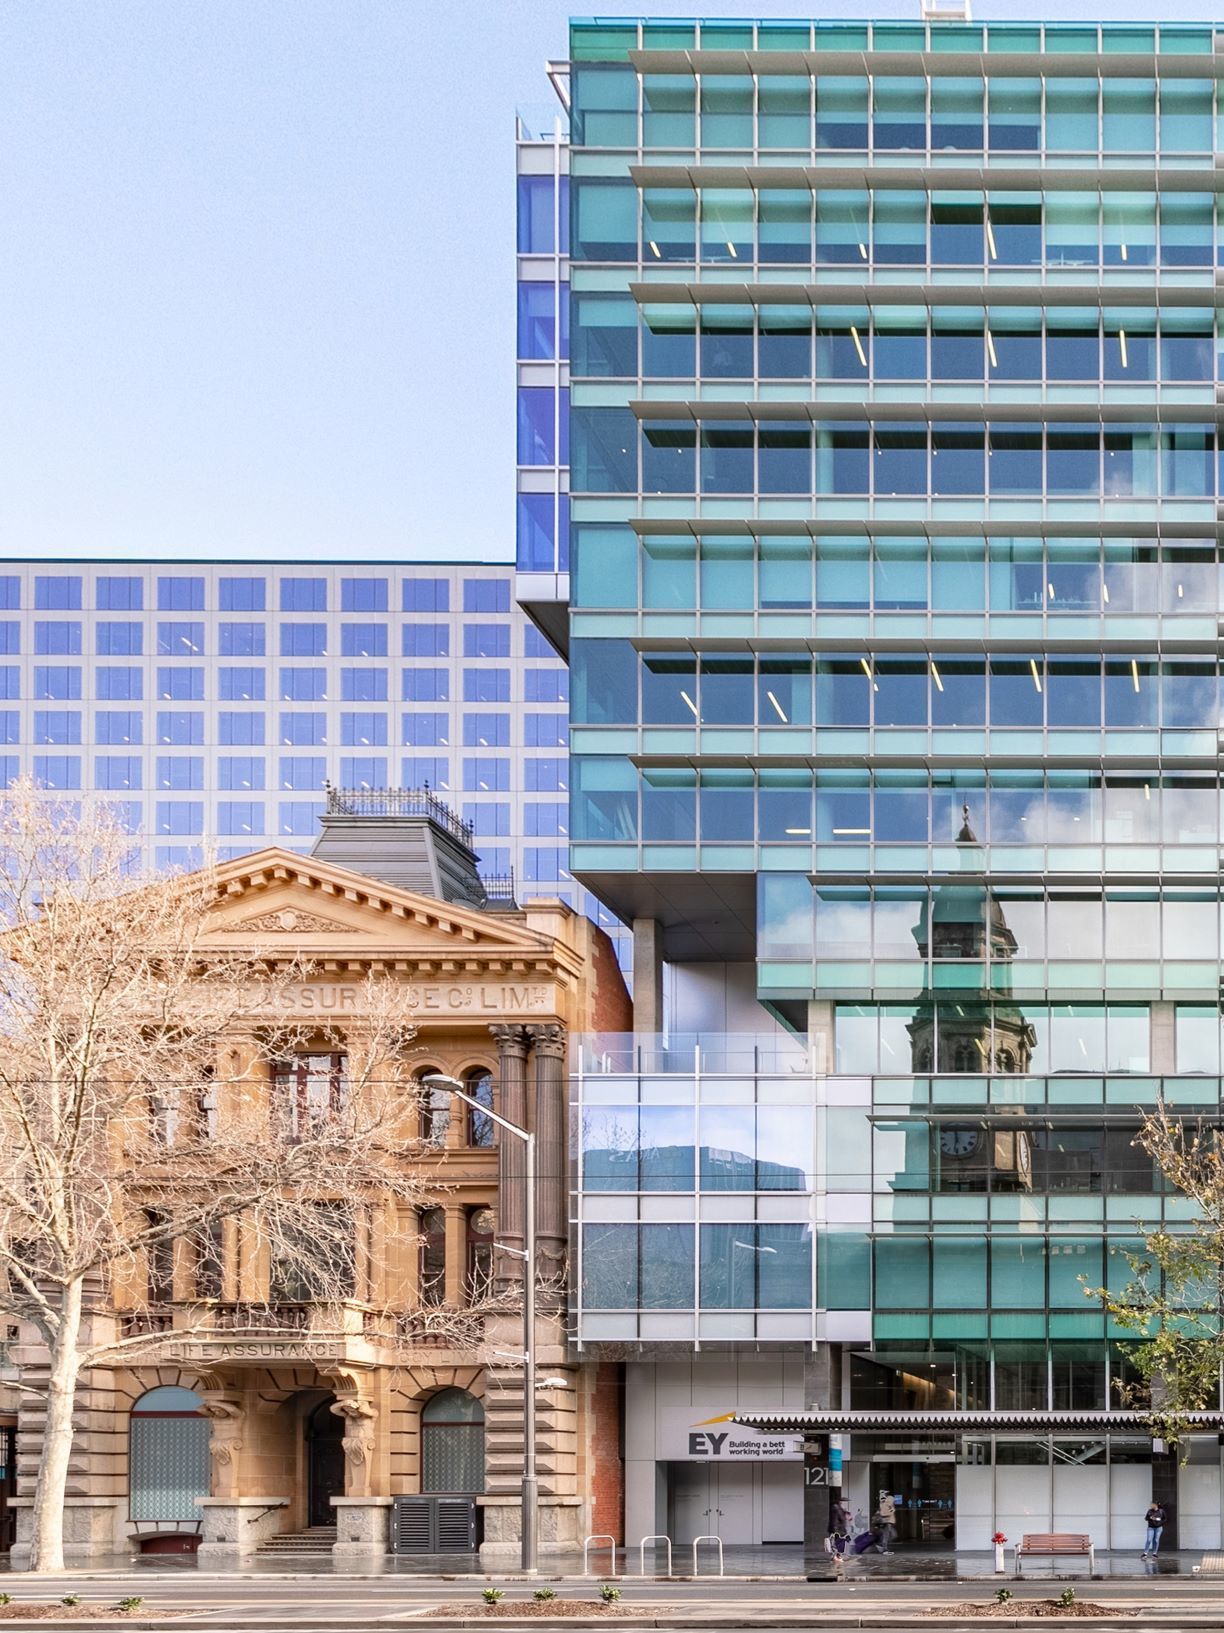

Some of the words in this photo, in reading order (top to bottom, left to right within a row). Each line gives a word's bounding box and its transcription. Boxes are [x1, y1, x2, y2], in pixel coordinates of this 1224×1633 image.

[170, 1343, 213, 1357] LIFE
[221, 1343, 338, 1357] ASSURANCE
[688, 1432, 729, 1455] EY
[729, 1440, 761, 1450] Building
[769, 1440, 785, 1448] bett
[729, 1448, 760, 1457] working
[803, 1467, 829, 1486] 121
